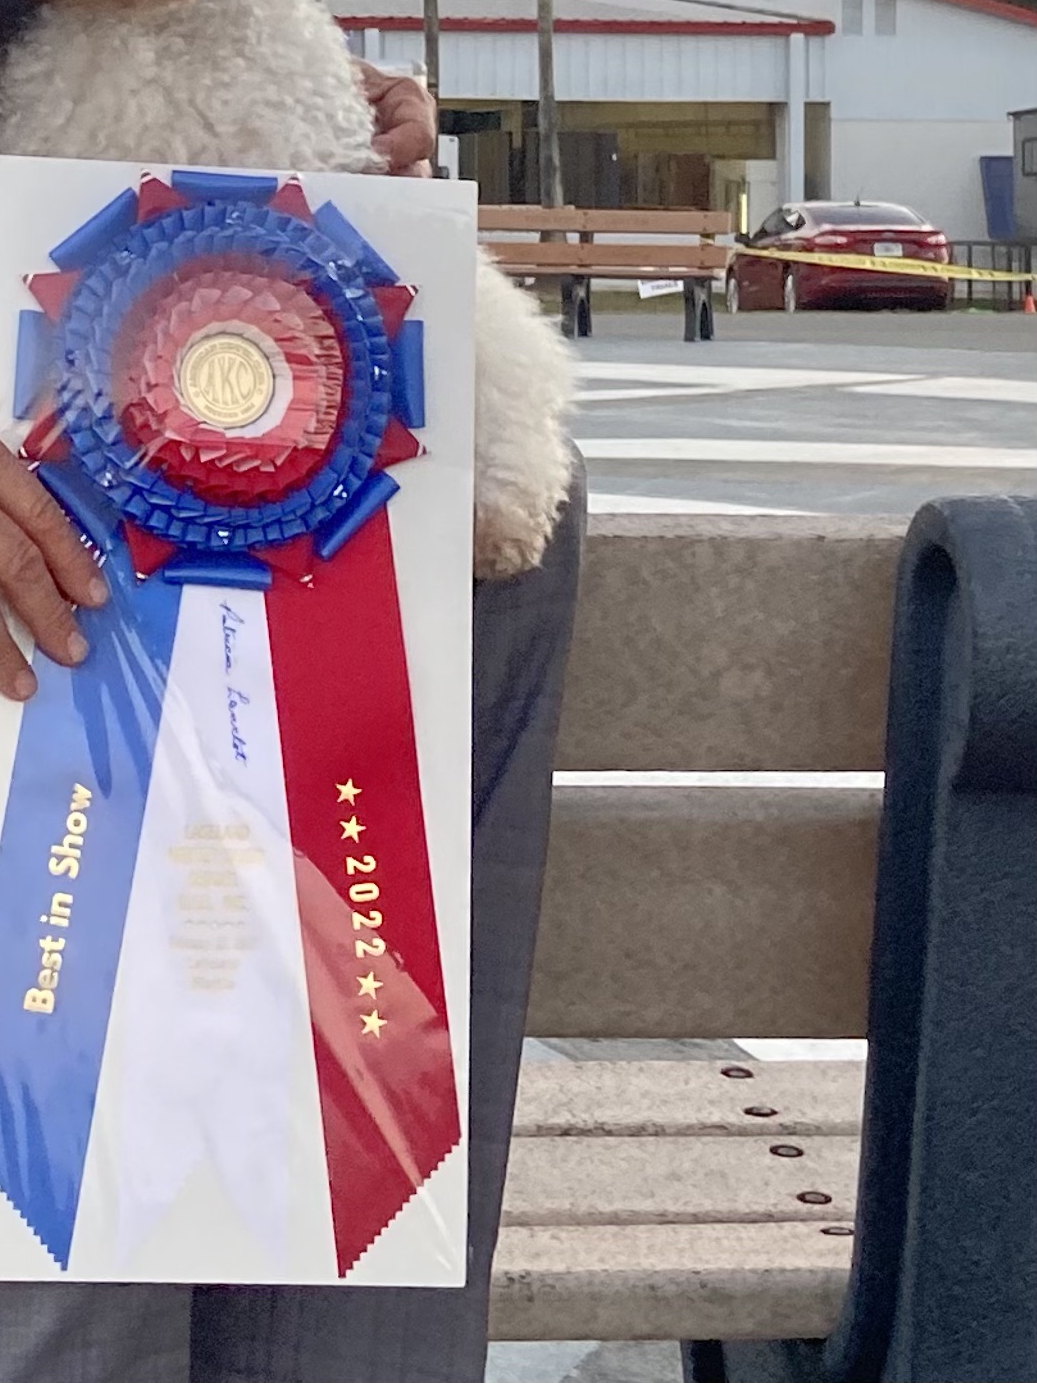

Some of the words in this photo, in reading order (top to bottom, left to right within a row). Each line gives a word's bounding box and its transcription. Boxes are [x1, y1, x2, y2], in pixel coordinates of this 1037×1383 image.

[201, 354, 251, 408] AKC
[48, 783, 93, 880] Show
[40, 891, 74, 927] in
[345, 854, 387, 959] 2022
[23, 935, 66, 1014] Best
